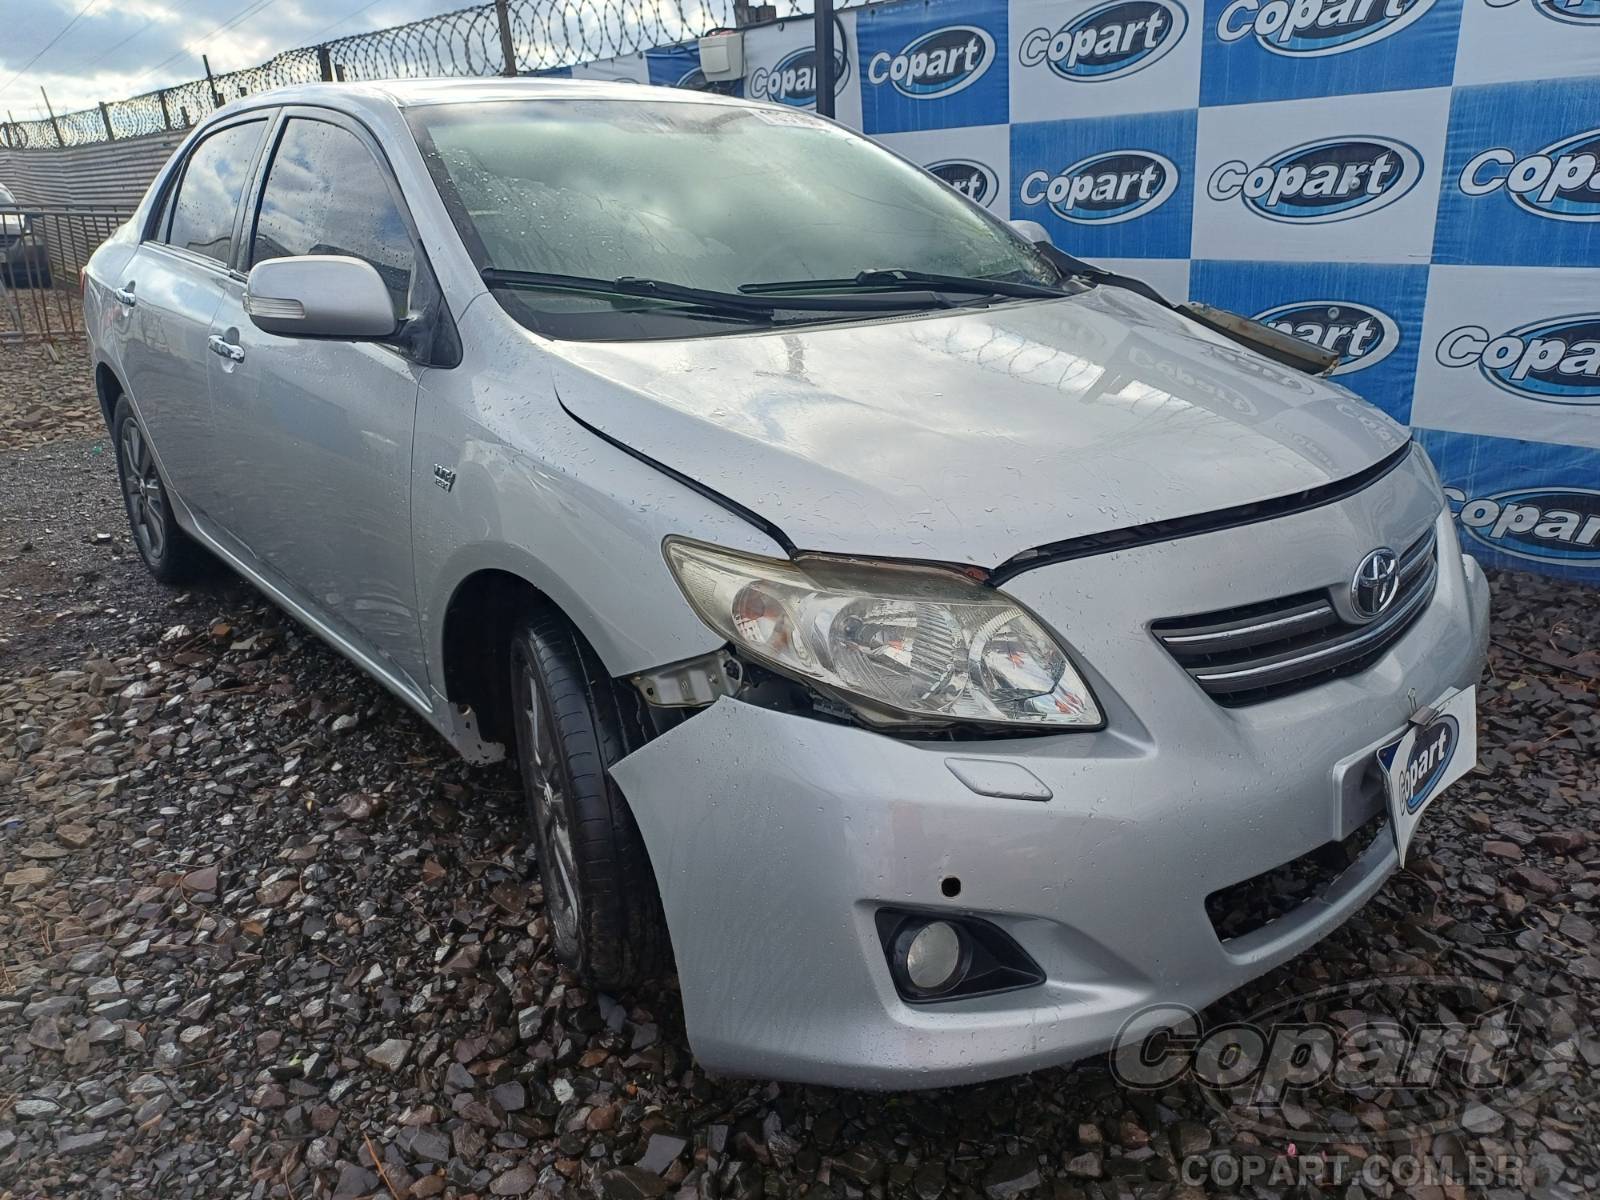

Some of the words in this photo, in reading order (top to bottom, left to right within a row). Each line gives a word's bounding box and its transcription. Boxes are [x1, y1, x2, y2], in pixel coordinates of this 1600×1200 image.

[868, 34, 980, 87] Copart
[1019, 8, 1165, 68] Copart
[751, 66, 816, 100] Copa
[1019, 161, 1158, 211] Copart
[1207, 151, 1394, 207] Copart
[1459, 147, 1600, 203] Cop
[1399, 728, 1447, 816] Copart
